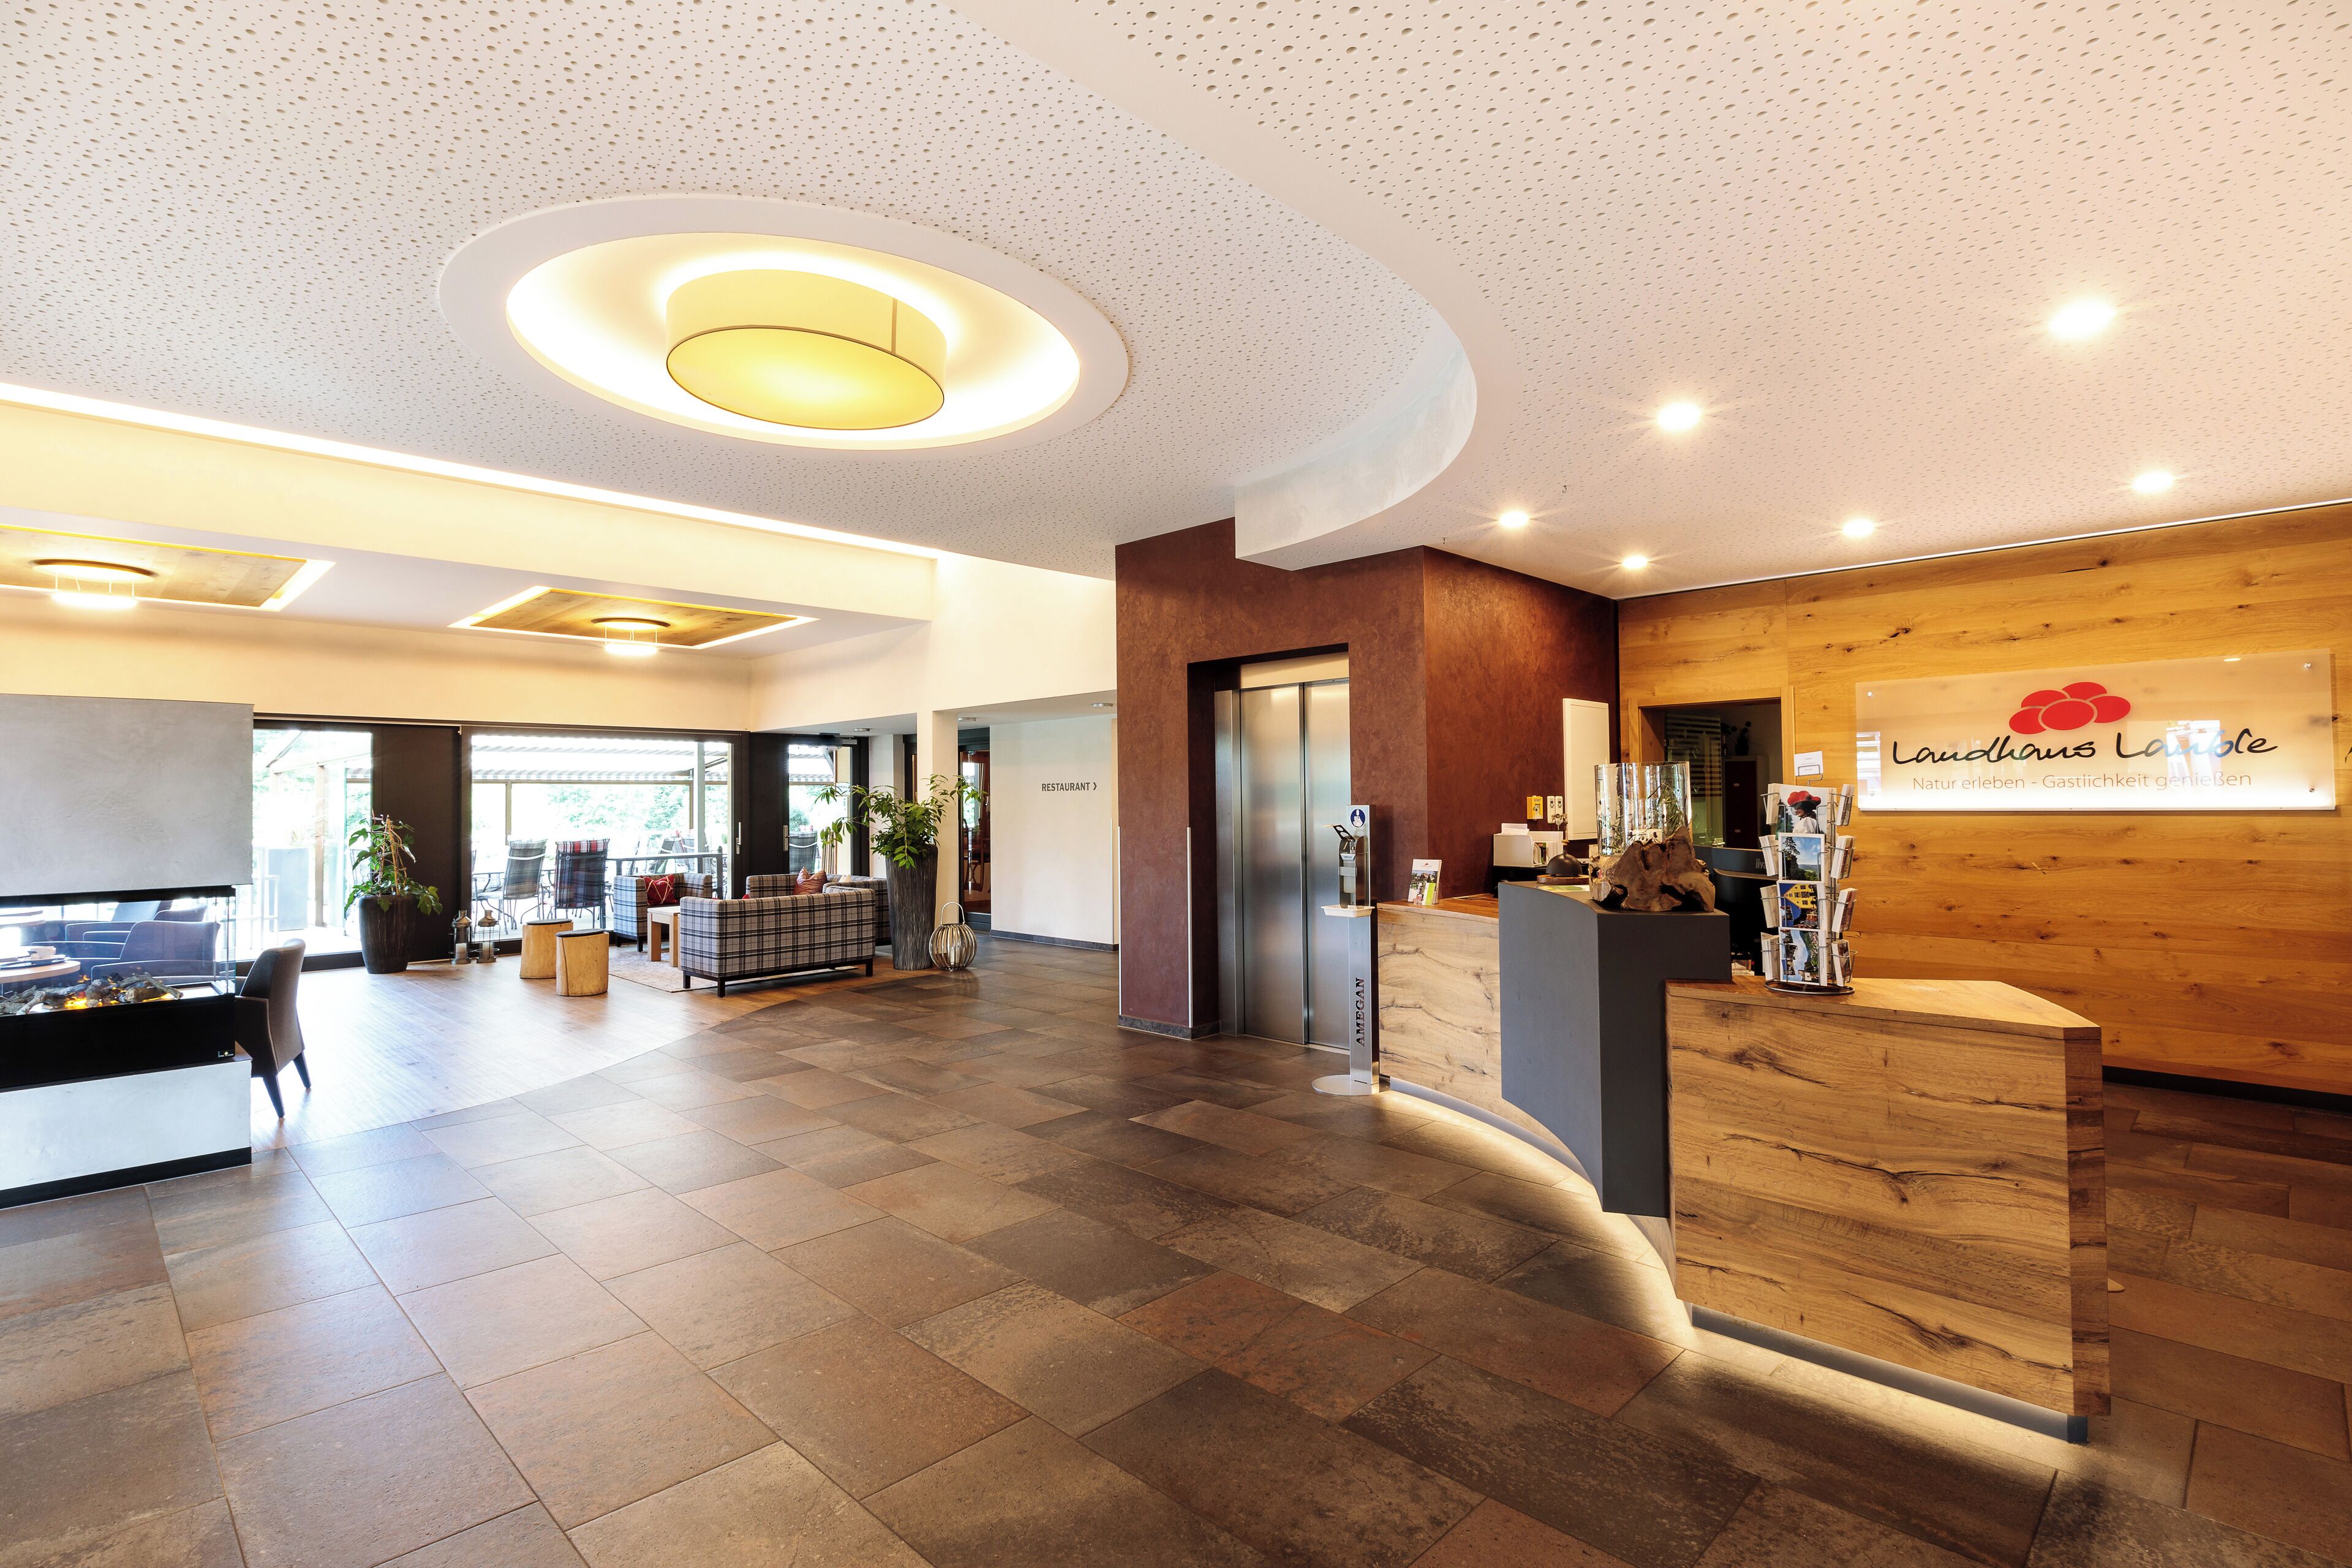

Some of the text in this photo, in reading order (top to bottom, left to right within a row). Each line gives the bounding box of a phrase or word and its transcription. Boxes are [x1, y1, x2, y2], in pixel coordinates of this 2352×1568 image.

[1893, 728, 2278, 764] Landhaus Lauble
[1042, 782, 1090, 791] RESTAURANT
[1913, 777, 1956, 790] Natur
[1961, 775, 2025, 790] erleben
[2043, 774, 2149, 788] Gastlichkeit
[2155, 771, 2251, 790] genießen
[1355, 978, 1365, 1047] AMEGAN
